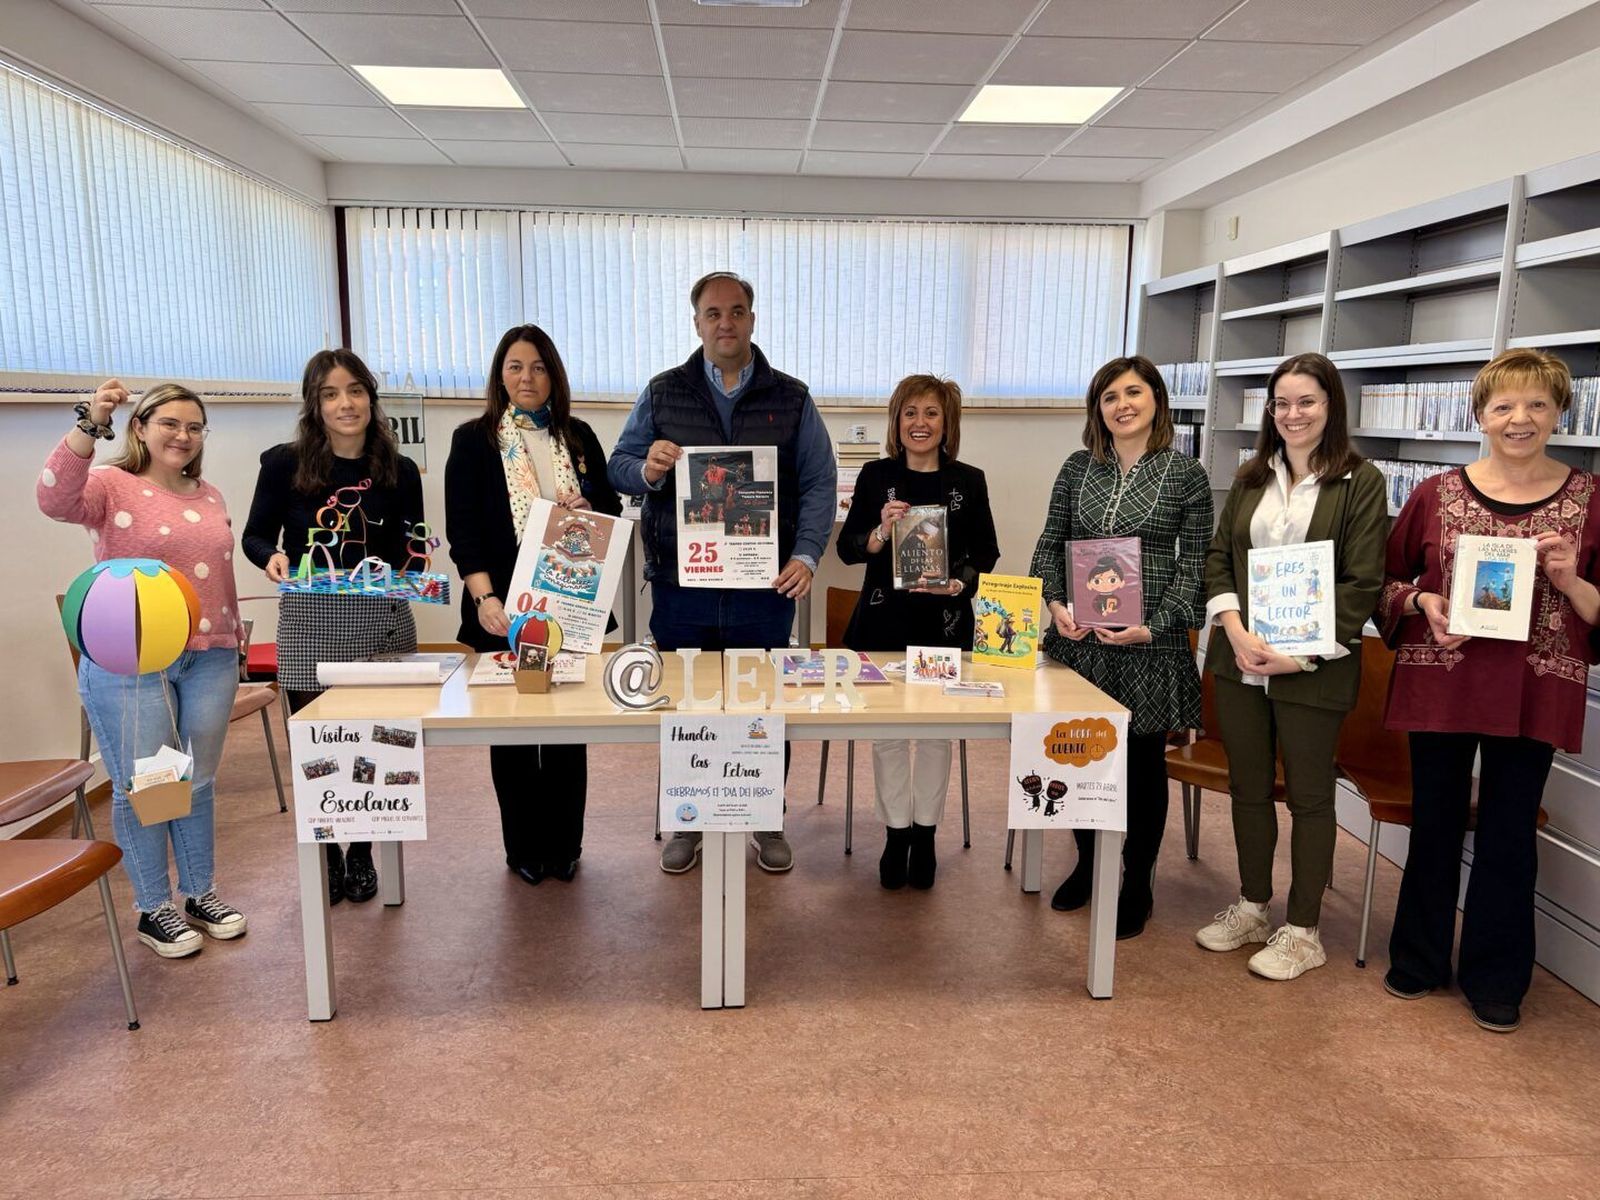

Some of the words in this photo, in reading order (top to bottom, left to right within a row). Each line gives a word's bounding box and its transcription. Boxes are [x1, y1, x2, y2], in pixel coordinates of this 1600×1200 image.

[688, 541, 718, 563] 25
[900, 548, 943, 557] ALIENTO
[684, 566, 724, 574] VIERNES
[904, 564, 940, 573] LLAMAS
[1275, 561, 1305, 578] ERES
[1281, 583, 1297, 597] UN
[517, 592, 549, 613] 04
[1267, 604, 1312, 621] LECTOR
[310, 725, 363, 744] Visitas
[671, 725, 718, 742] Hundir
[1070, 728, 1091, 739] HORA
[1051, 742, 1086, 754] CUENTO
[690, 753, 711, 769] las
[722, 761, 763, 778] Letras
[666, 786, 711, 798] CELEBRAMOS
[320, 790, 412, 814] Escolares
